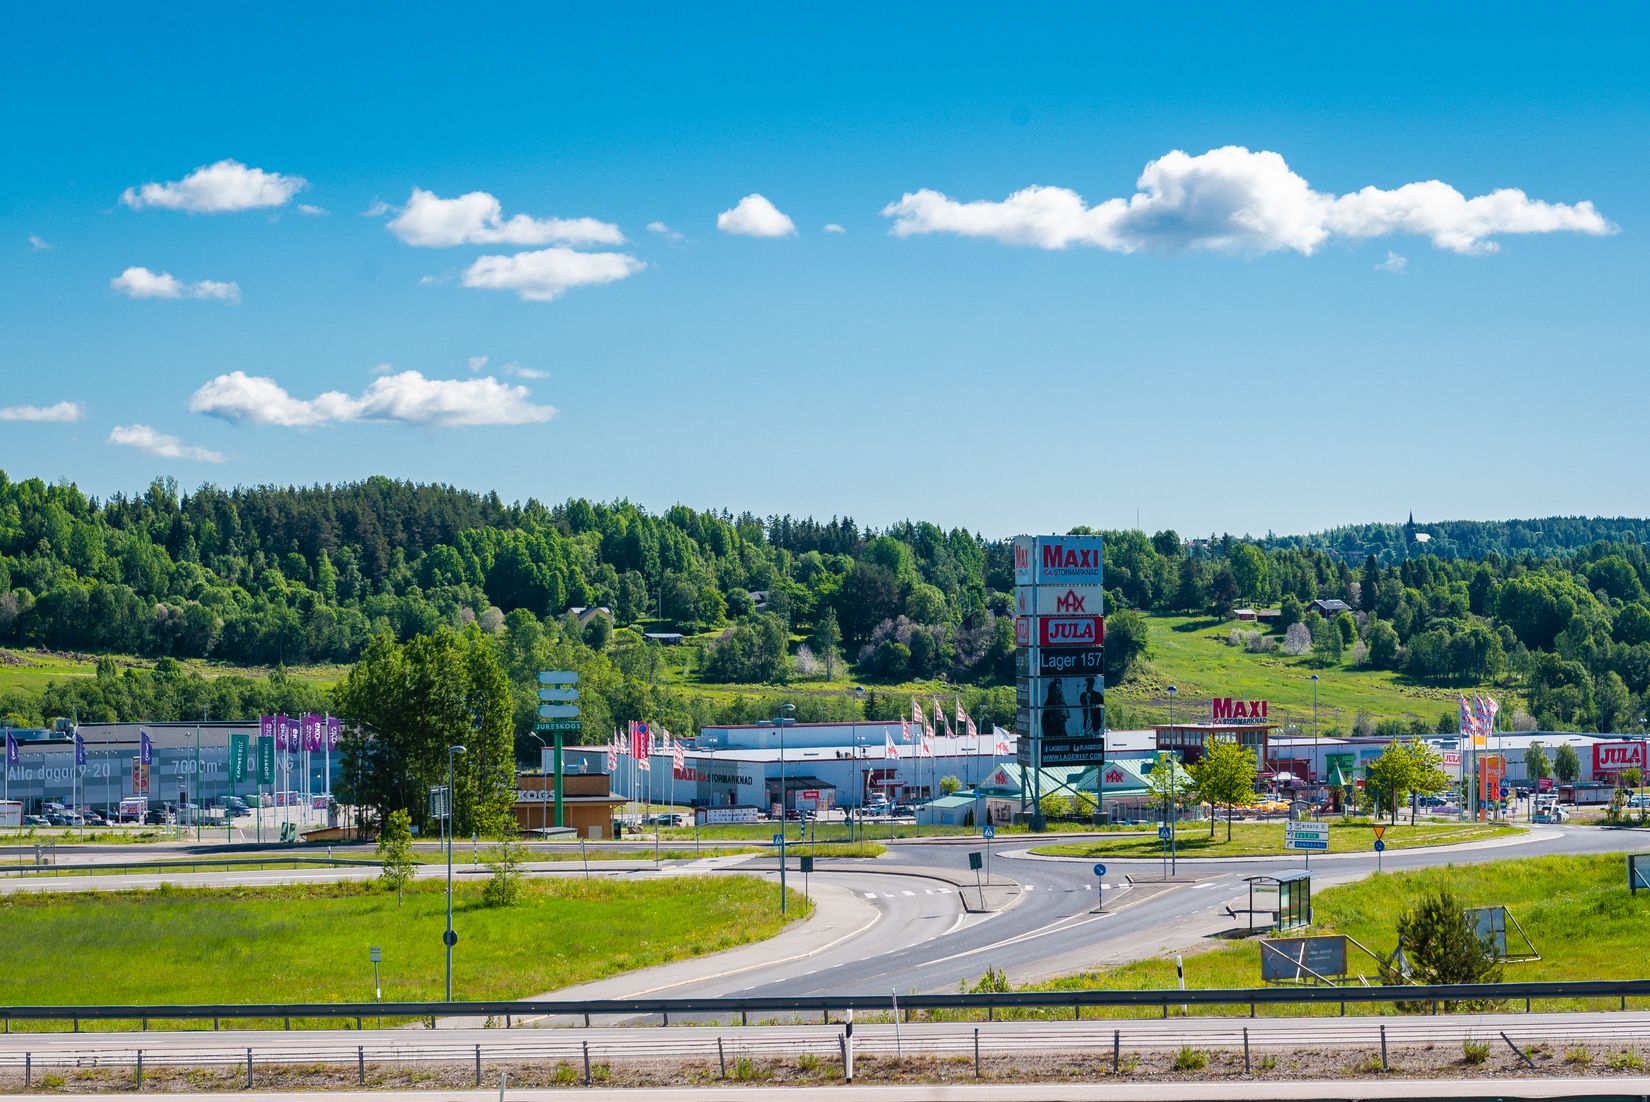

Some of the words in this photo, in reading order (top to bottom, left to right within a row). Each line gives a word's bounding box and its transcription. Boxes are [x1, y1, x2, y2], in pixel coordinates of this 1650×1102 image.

[1043, 544, 1099, 568] MAXI
[1053, 568, 1099, 576] STORMARKNAD
[1057, 589, 1086, 612] MAX
[1049, 623, 1093, 639] JULA
[1041, 654, 1077, 671] Lager
[1080, 652, 1102, 667] 157
[1212, 698, 1268, 719] MAXI
[536, 723, 581, 731] JURESKOGS
[1600, 747, 1641, 765] JULA
[8, 766, 33, 781] Alla
[37, 765, 75, 782] dagar
[707, 773, 753, 786] STORMARKNAD
[1105, 770, 1124, 783] MAX
